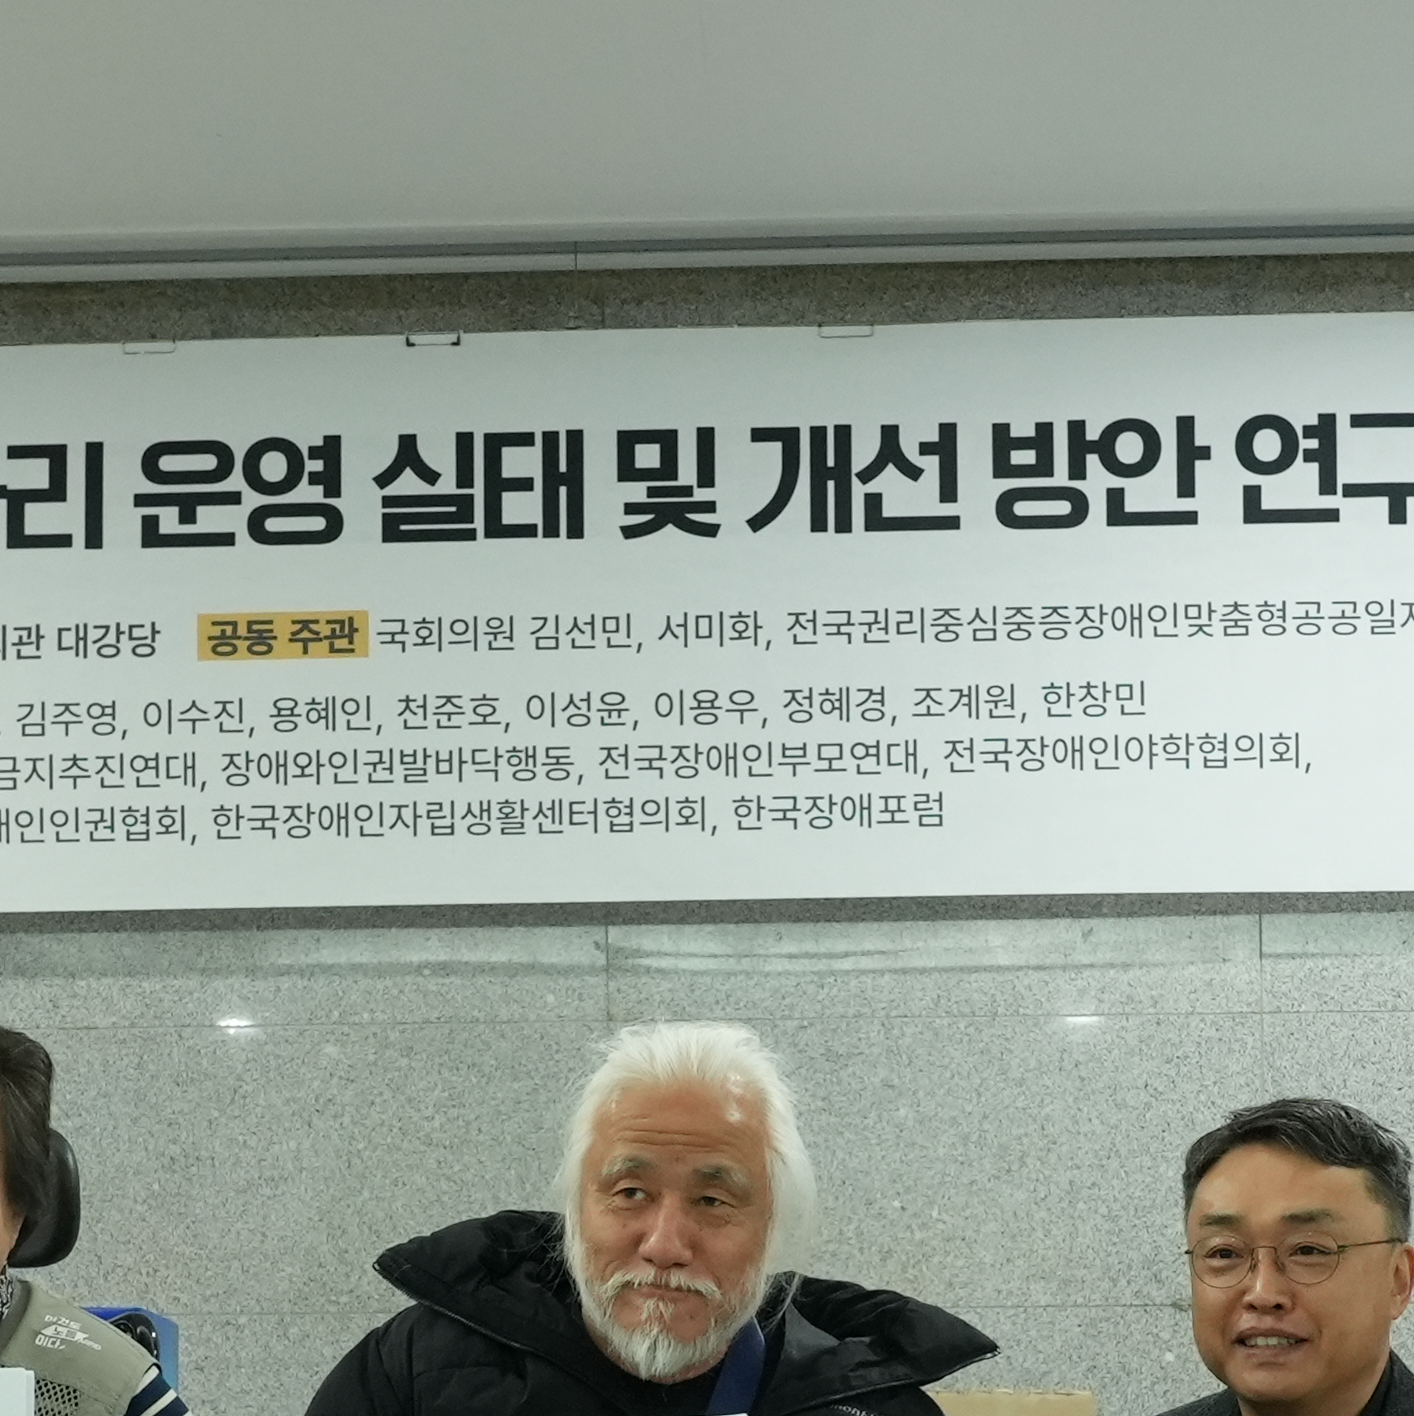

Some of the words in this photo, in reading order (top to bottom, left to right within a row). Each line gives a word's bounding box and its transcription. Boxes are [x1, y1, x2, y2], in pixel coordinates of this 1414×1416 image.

[134, 435, 344, 548] 운영
[372, 429, 584, 543] 실태
[617, 427, 721, 539] 및
[746, 423, 960, 533] 개선
[992, 416, 1211, 529] 방안
[58, 622, 161, 658] 대강당
[208, 620, 278, 656] 공동
[288, 616, 359, 655] 주관
[377, 616, 514, 653] 국회의원
[530, 613, 642, 653] 김선민,
[658, 611, 771, 651] 서미화,
[17, 700, 127, 740] 김주영,
[144, 698, 254, 738] 이수진,
[270, 696, 382, 735] 용혜인,
[398, 694, 510, 733] 천준호,
[527, 692, 638, 731] 이성윤,
[655, 690, 767, 728] 이용우,
[784, 686, 896, 726] 정혜경,
[912, 684, 1026, 723] 조계원,
[1042, 681, 1145, 717] 한창민
[222, 746, 583, 786] 장애와인권발바닥행동,
[599, 739, 928, 779] 전국장애인부모연대,
[944, 733, 1310, 773] 전국장애인야학협의회,
[212, 796, 716, 839] 한국장애인자립생활센터협의회,
[733, 792, 942, 830] 한국장애포럼
